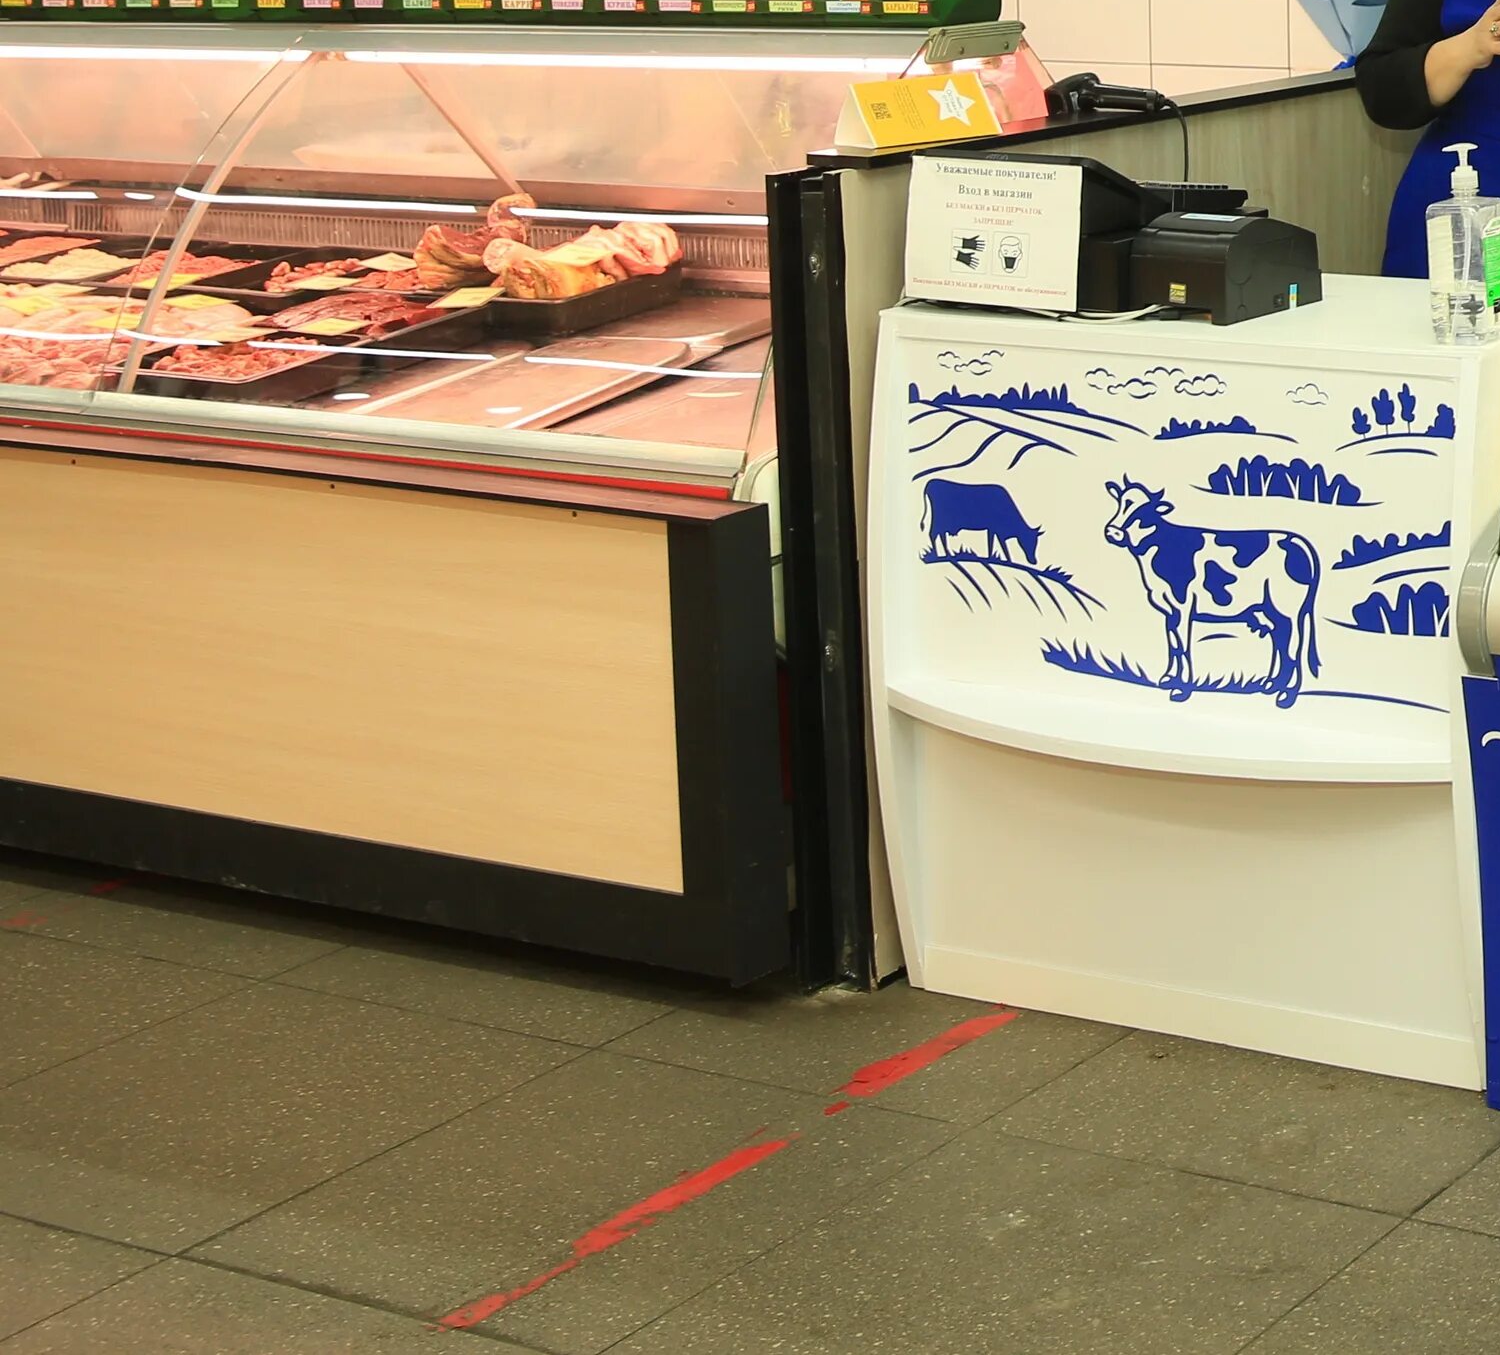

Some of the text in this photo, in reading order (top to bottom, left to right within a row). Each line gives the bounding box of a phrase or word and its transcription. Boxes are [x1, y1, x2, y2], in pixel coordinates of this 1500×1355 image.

[936, 162, 1057, 181] Уважаемые покупатели!
[958, 184, 981, 196] Вход
[992, 190, 1033, 200] магазин
